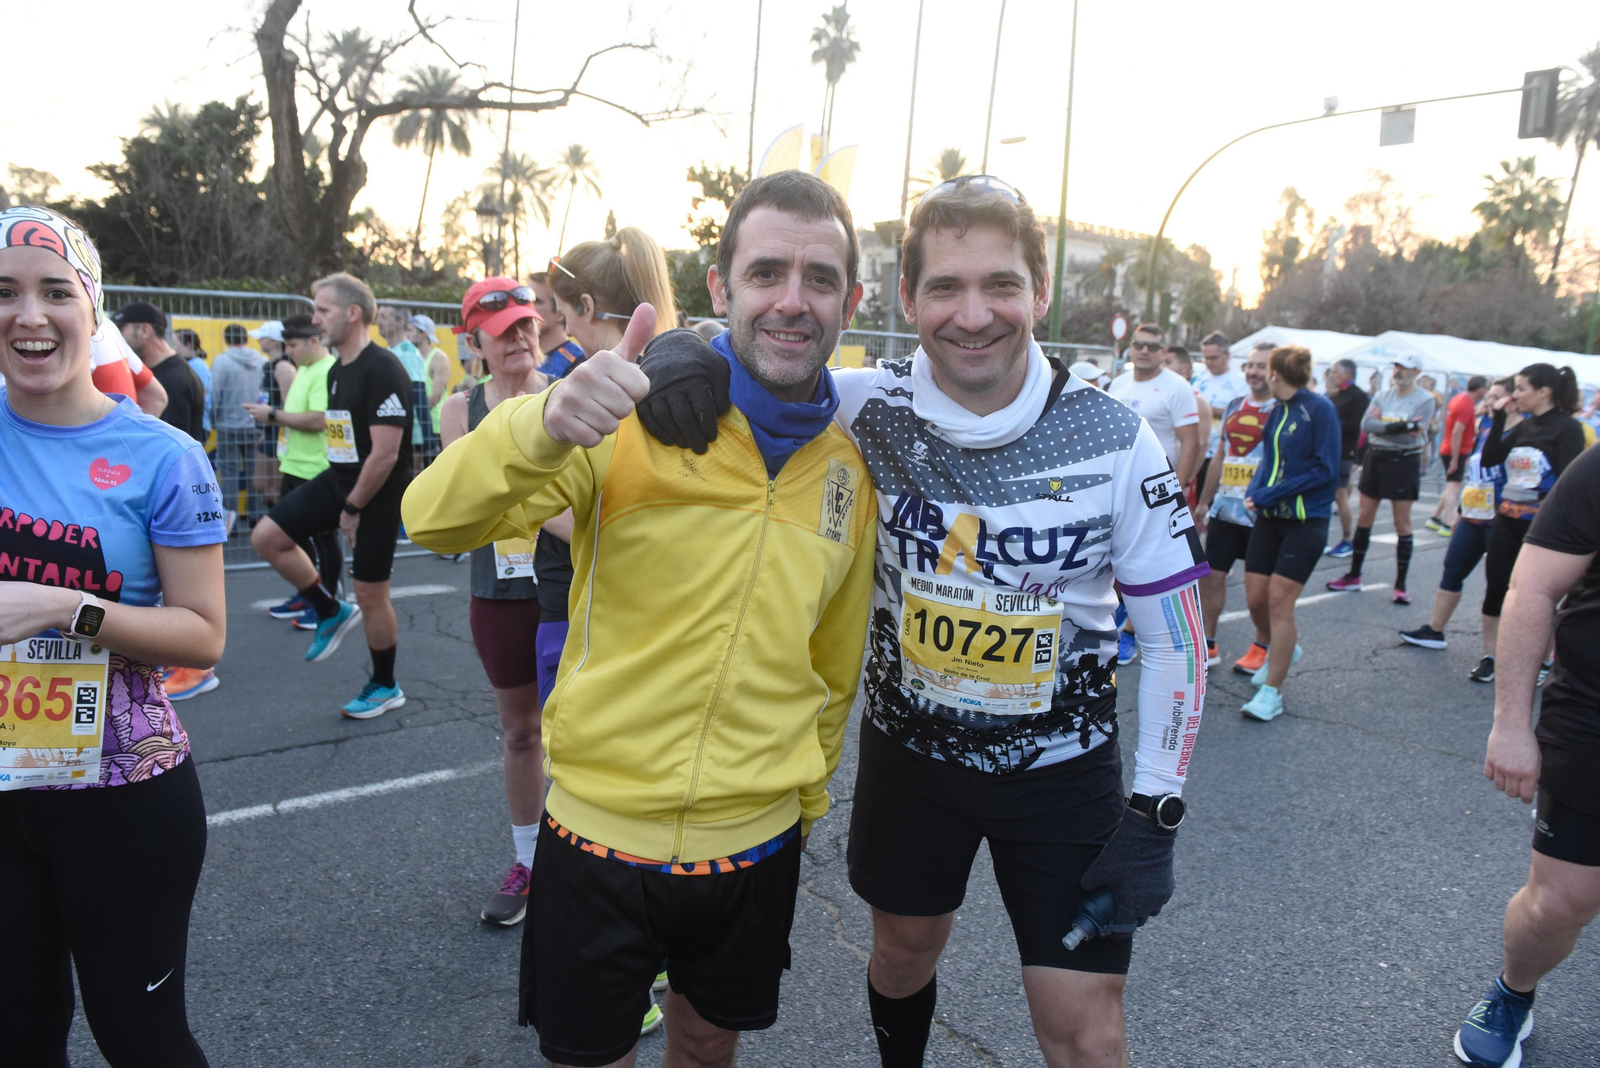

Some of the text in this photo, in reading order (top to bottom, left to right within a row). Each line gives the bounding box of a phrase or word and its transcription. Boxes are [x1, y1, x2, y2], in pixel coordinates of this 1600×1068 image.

[1034, 492, 1074, 503] SPALL
[910, 577, 1040, 613] MEDIO MARATÓN SEVILLA
[914, 608, 1034, 663] 10727
[27, 639, 82, 660] SEVILLA
[951, 656, 985, 668] Jm Nieto
[943, 668, 960, 676] Nieto
[976, 674, 991, 682] Cruz
[959, 697, 982, 706] HOKA
[1168, 701, 1185, 751] PubliPrenda
[1186, 715, 1200, 731] DEL
